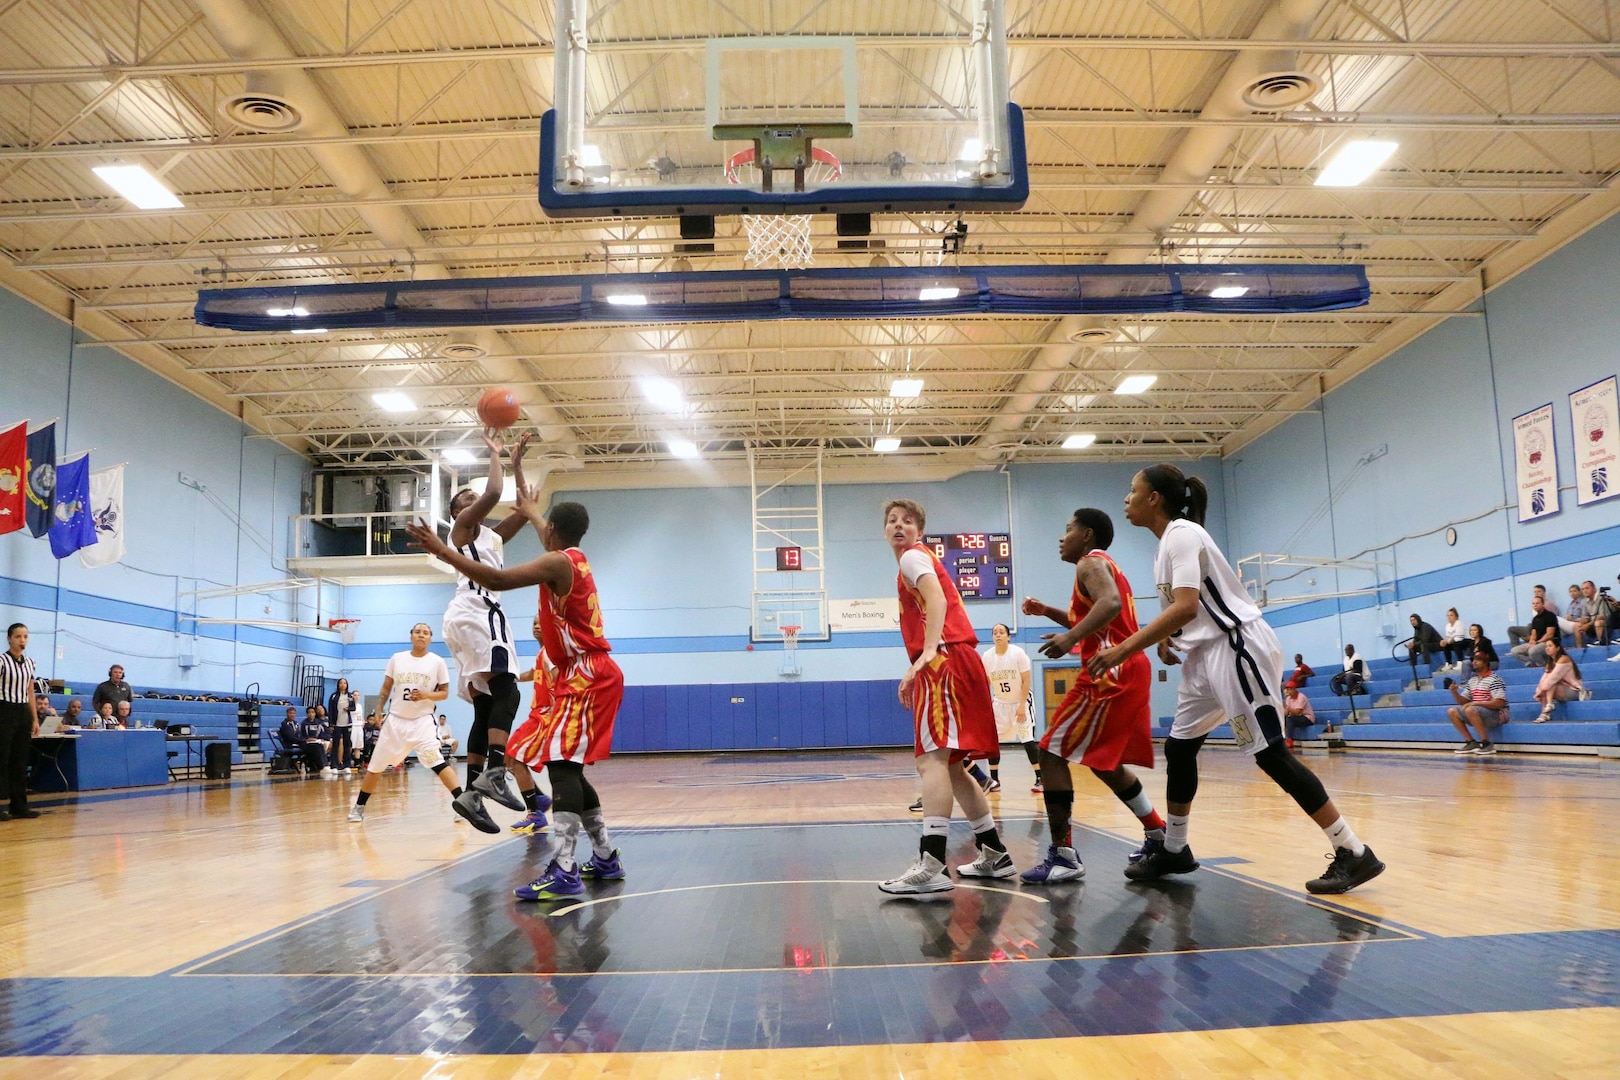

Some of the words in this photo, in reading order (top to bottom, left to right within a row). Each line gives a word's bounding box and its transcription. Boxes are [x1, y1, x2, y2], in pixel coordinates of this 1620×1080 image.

[956, 534, 985, 549] 7:26
[935, 544, 945, 559] 8
[1000, 543, 1009, 557] 8
[785, 549, 799, 566] 13
[959, 557, 976, 565] period
[959, 567, 977, 575] player
[862, 611, 885, 619] Boxing
[396, 672, 431, 688] NAVY
[999, 682, 1011, 693] 15
